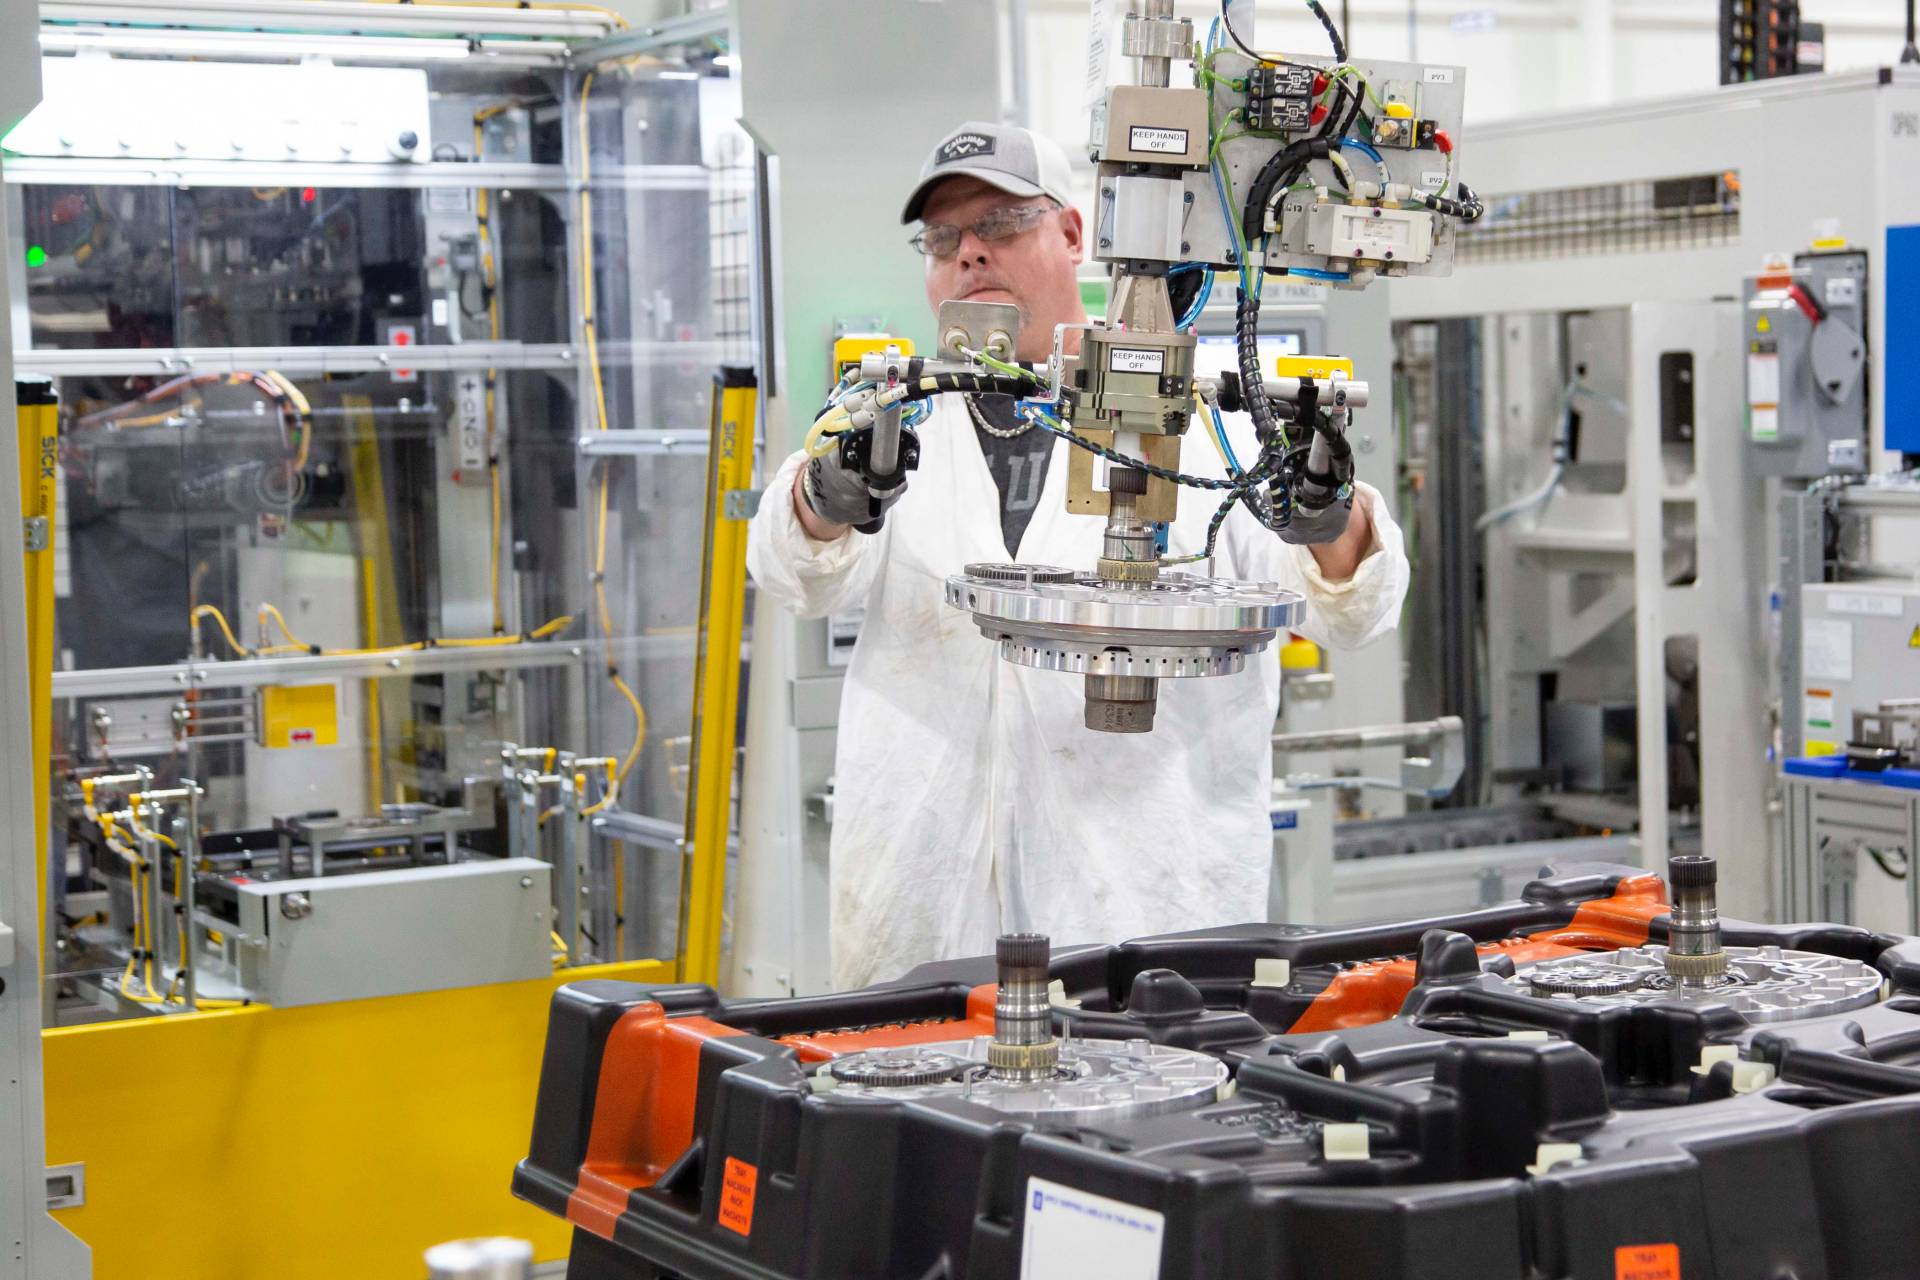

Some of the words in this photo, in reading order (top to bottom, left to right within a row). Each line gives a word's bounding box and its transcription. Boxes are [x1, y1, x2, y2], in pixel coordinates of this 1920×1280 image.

[1133, 130, 1155, 139] KEEP
[1157, 132, 1185, 141] HANDS
[1150, 141, 1167, 149] OFF
[1113, 352, 1134, 360] KEEP
[1135, 353, 1161, 361] HANDS
[723, 421, 737, 459] SICK
[41, 435, 55, 479] SICK
